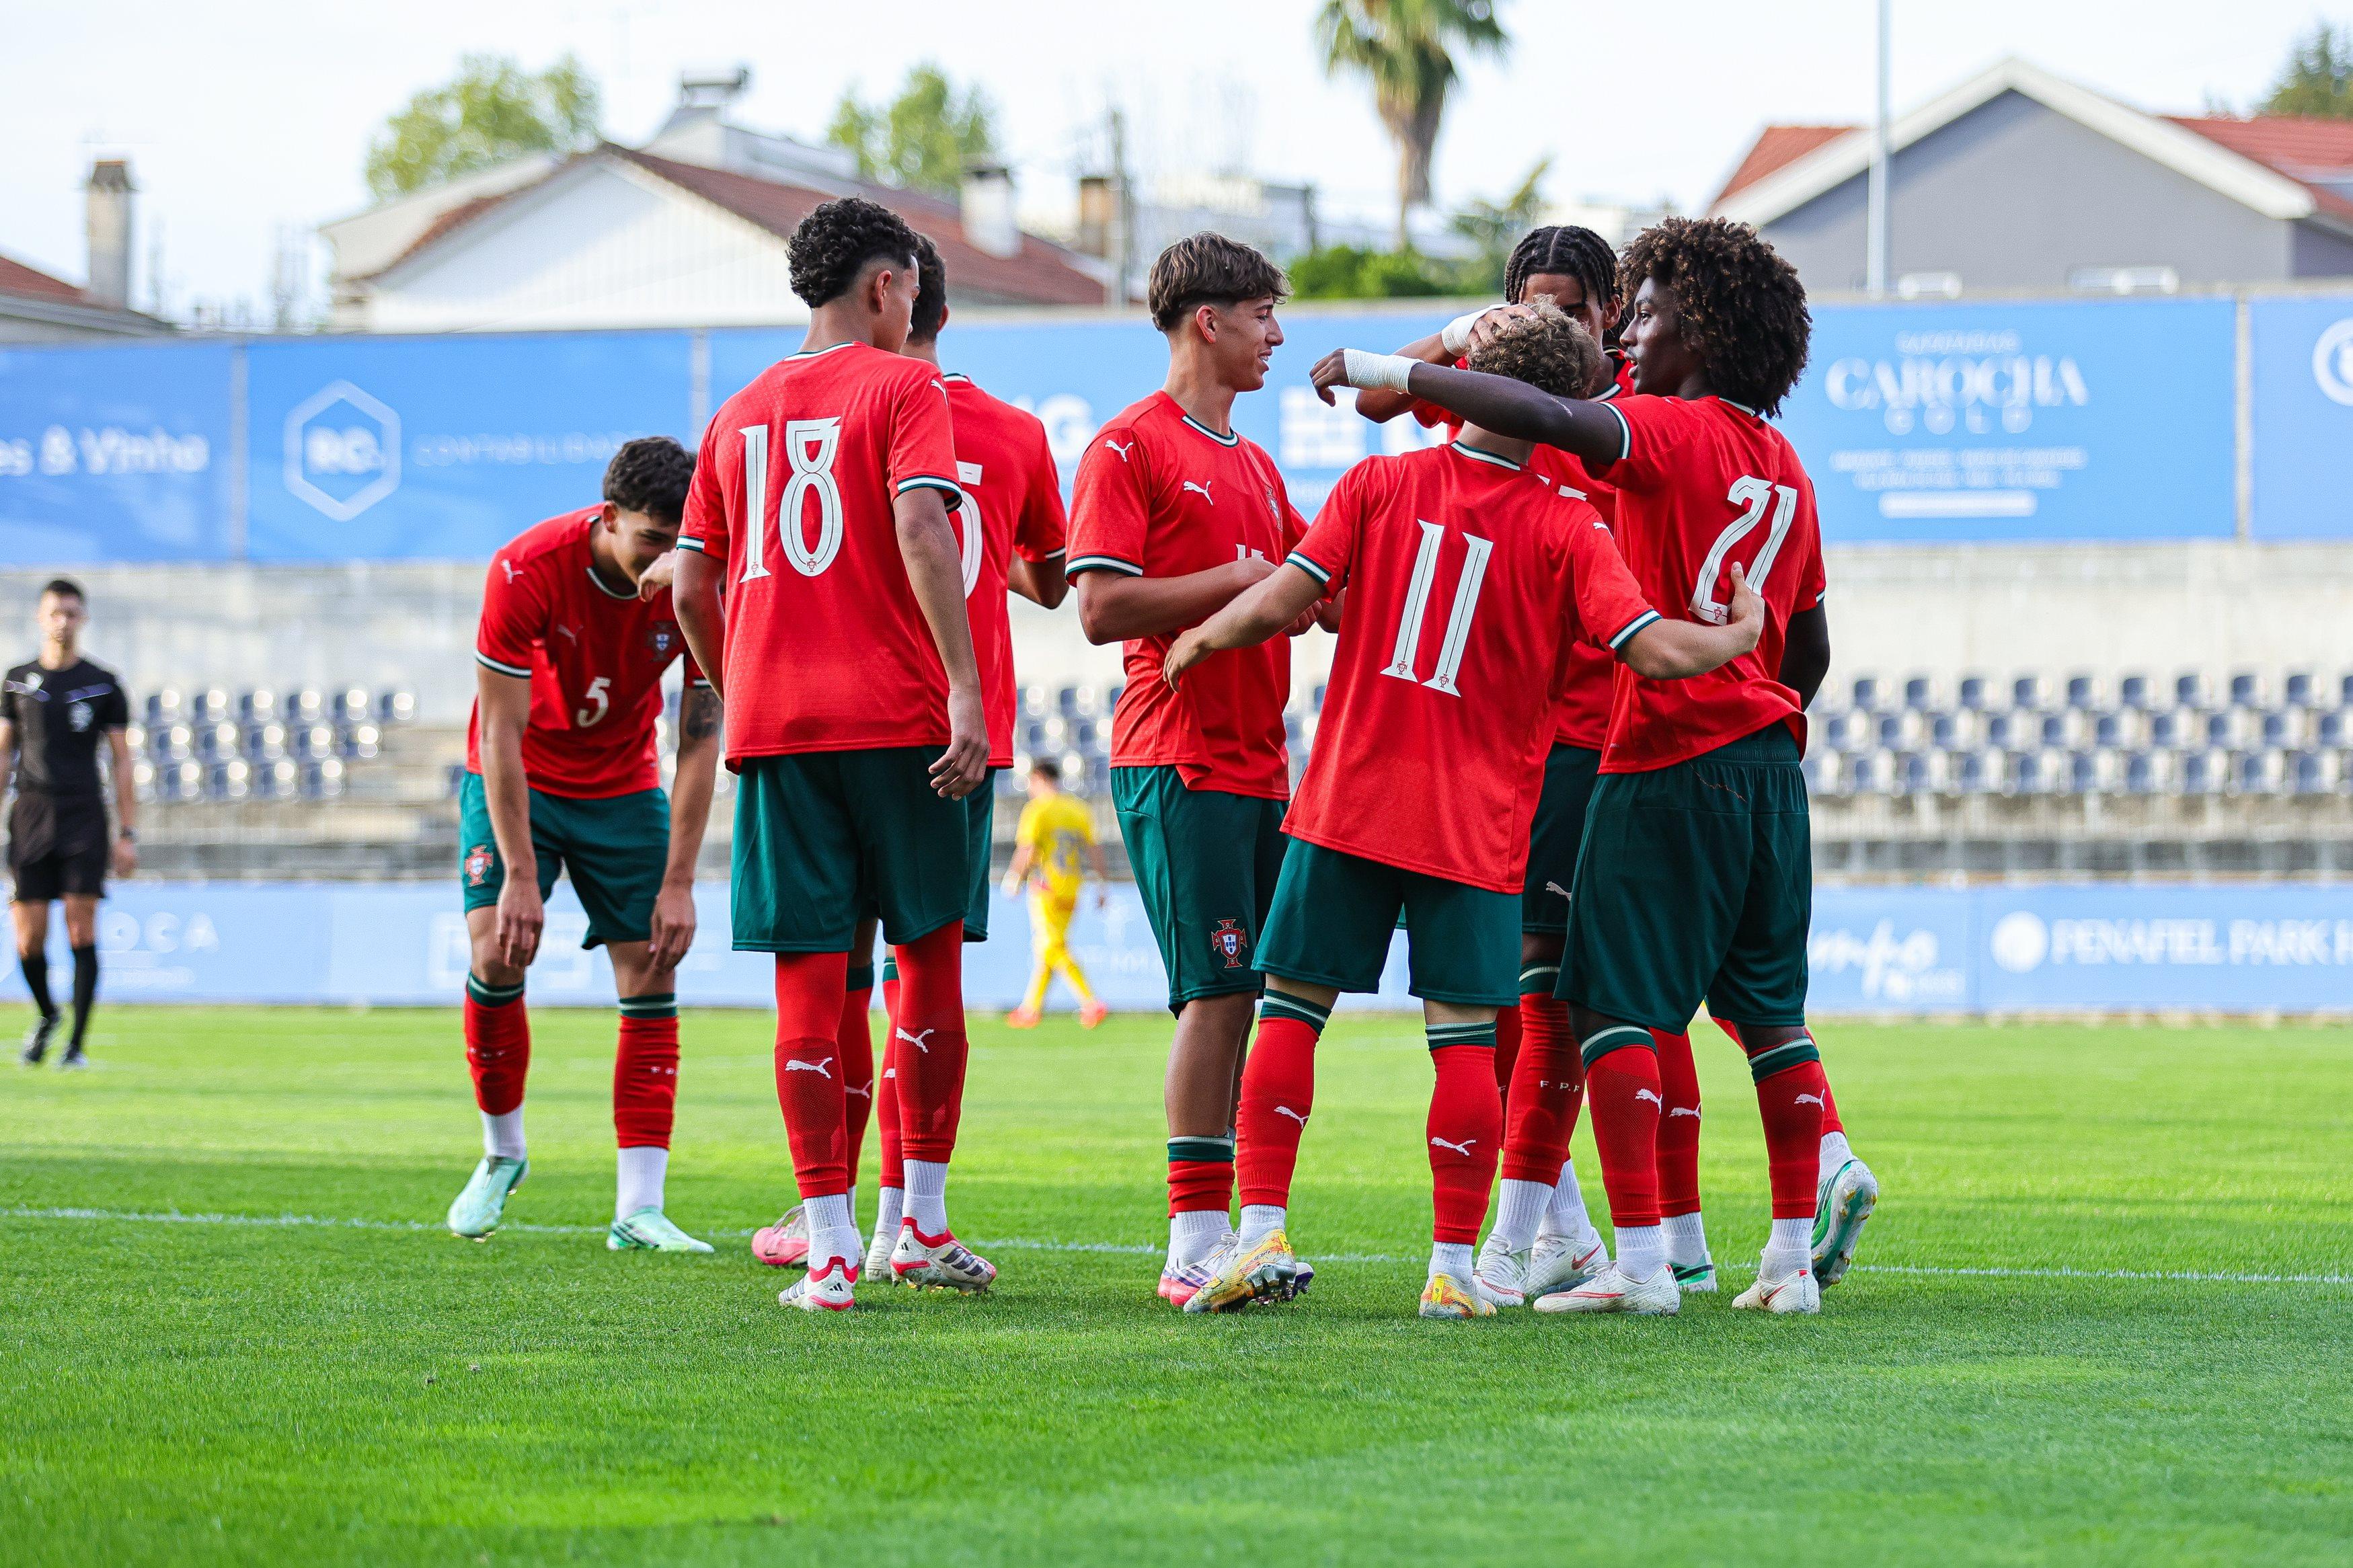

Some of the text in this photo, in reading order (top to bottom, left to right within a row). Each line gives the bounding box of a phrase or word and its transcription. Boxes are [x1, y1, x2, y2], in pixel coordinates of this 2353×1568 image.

[739, 416, 843, 583] 18
[1689, 475, 1798, 625] 21
[1381, 518, 1494, 697] 11
[577, 676, 611, 728] 5
